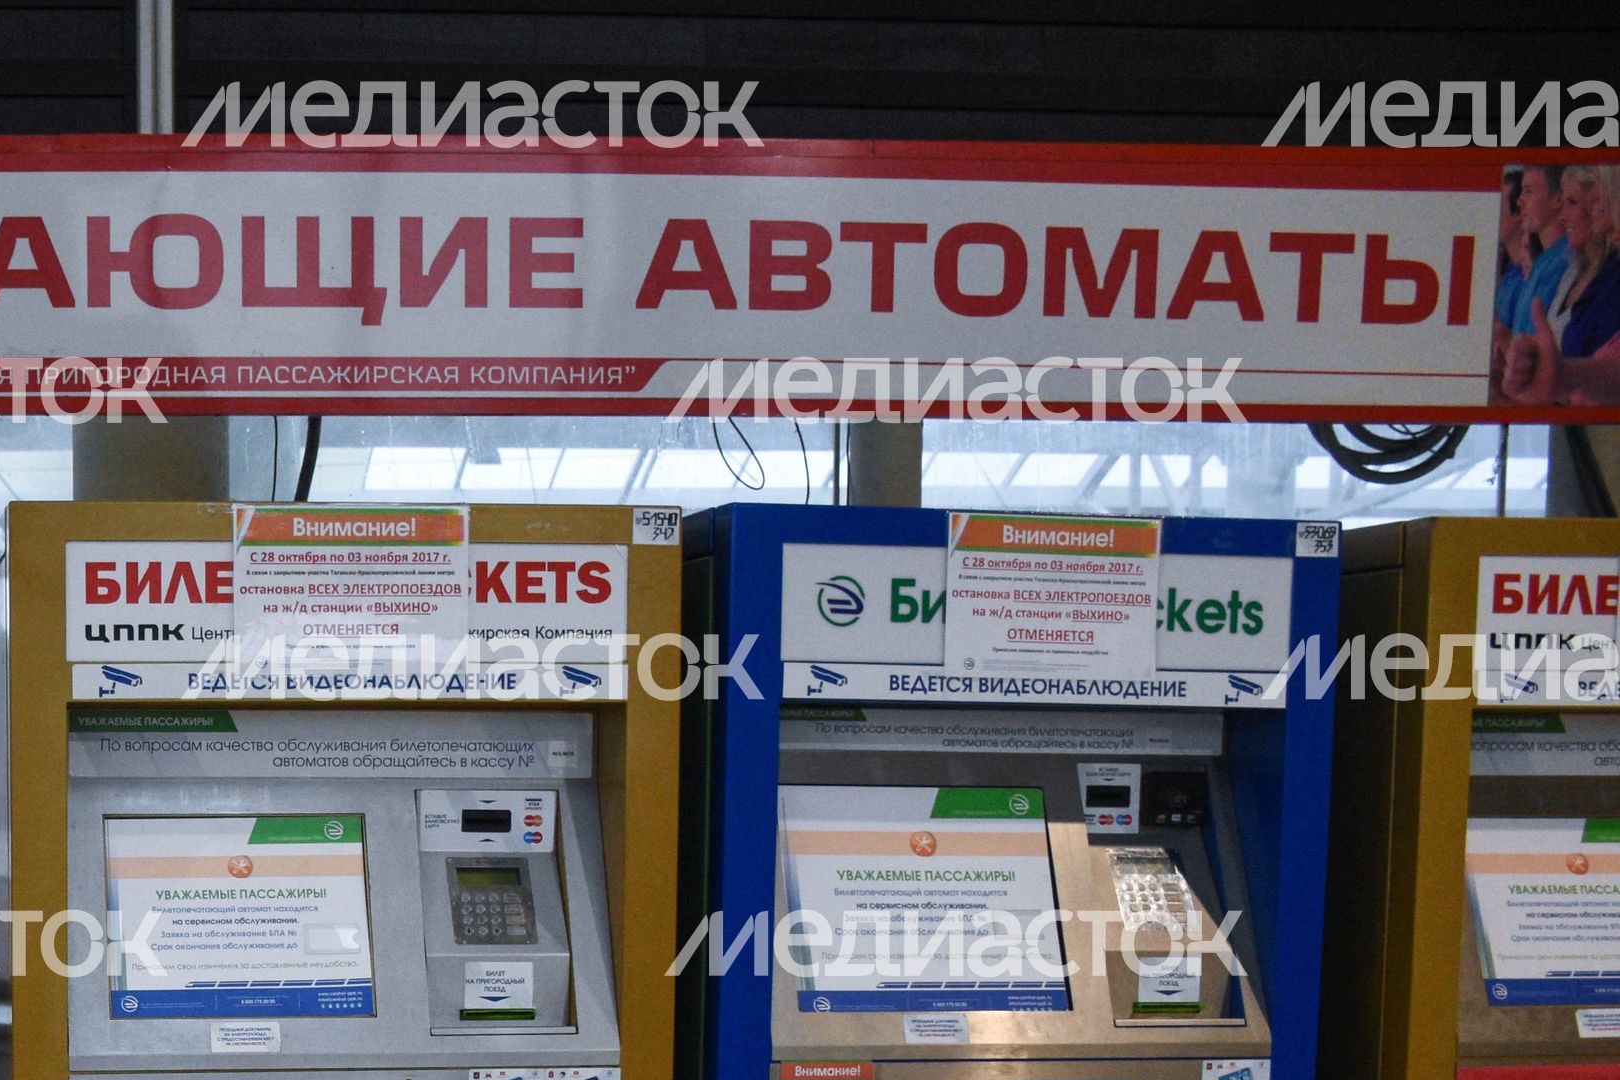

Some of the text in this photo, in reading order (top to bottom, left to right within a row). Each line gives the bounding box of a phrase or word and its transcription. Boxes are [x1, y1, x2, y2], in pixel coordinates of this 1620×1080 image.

[637, 214, 1475, 326] АВТОМАТЫ
[25, 365, 226, 389] ПРИГОРОДНАЯ
[236, 364, 460, 385] ПАССАЖИРСКАЯ
[292, 517, 417, 538] Внимание!
[1002, 524, 1115, 548] Внимание!
[260, 551, 440, 565] 28 октября по 03 ноября 2017
[972, 557, 1134, 573] 28 октября 03 ноября 2017
[84, 560, 234, 604] БИЛЕ
[468, 559, 612, 604] KETS
[239, 583, 462, 597] остановка ВСЕХ ЭЛЕКТРОПОЕЗДОВ
[951, 589, 1151, 606] остановка ВСЕХ ЭЛЕКТРОПОЕЗДОВ
[263, 601, 438, 615] на ж/д станции «ВЫХИНО»
[1015, 609, 1130, 622] станции «ВЫХИНО»
[84, 623, 613, 644] ЦППК Компания
[302, 624, 400, 636] ОТМЕНЯЕТСЯ
[1007, 628, 1094, 642] ОТМЕНЯЕТСЯ
[285, 672, 517, 693] ВИДЕОНАБЛЮДЕНИЕ
[889, 673, 1188, 699] ВЕДЕТСЯ ВИДЕОНАБЛЮДЕНИЕ
[77, 716, 214, 729] УВАЖАЕМЫЕ ПАССАЖИРЫ!
[836, 869, 1016, 882] УВАЖАЕМЫЕ ПАССАЖИРЫ!
[155, 888, 327, 901] УВАЖАЕМЫЕ ПАССАЖИРЫ!
[795, 1065, 861, 1077] Внимание!
